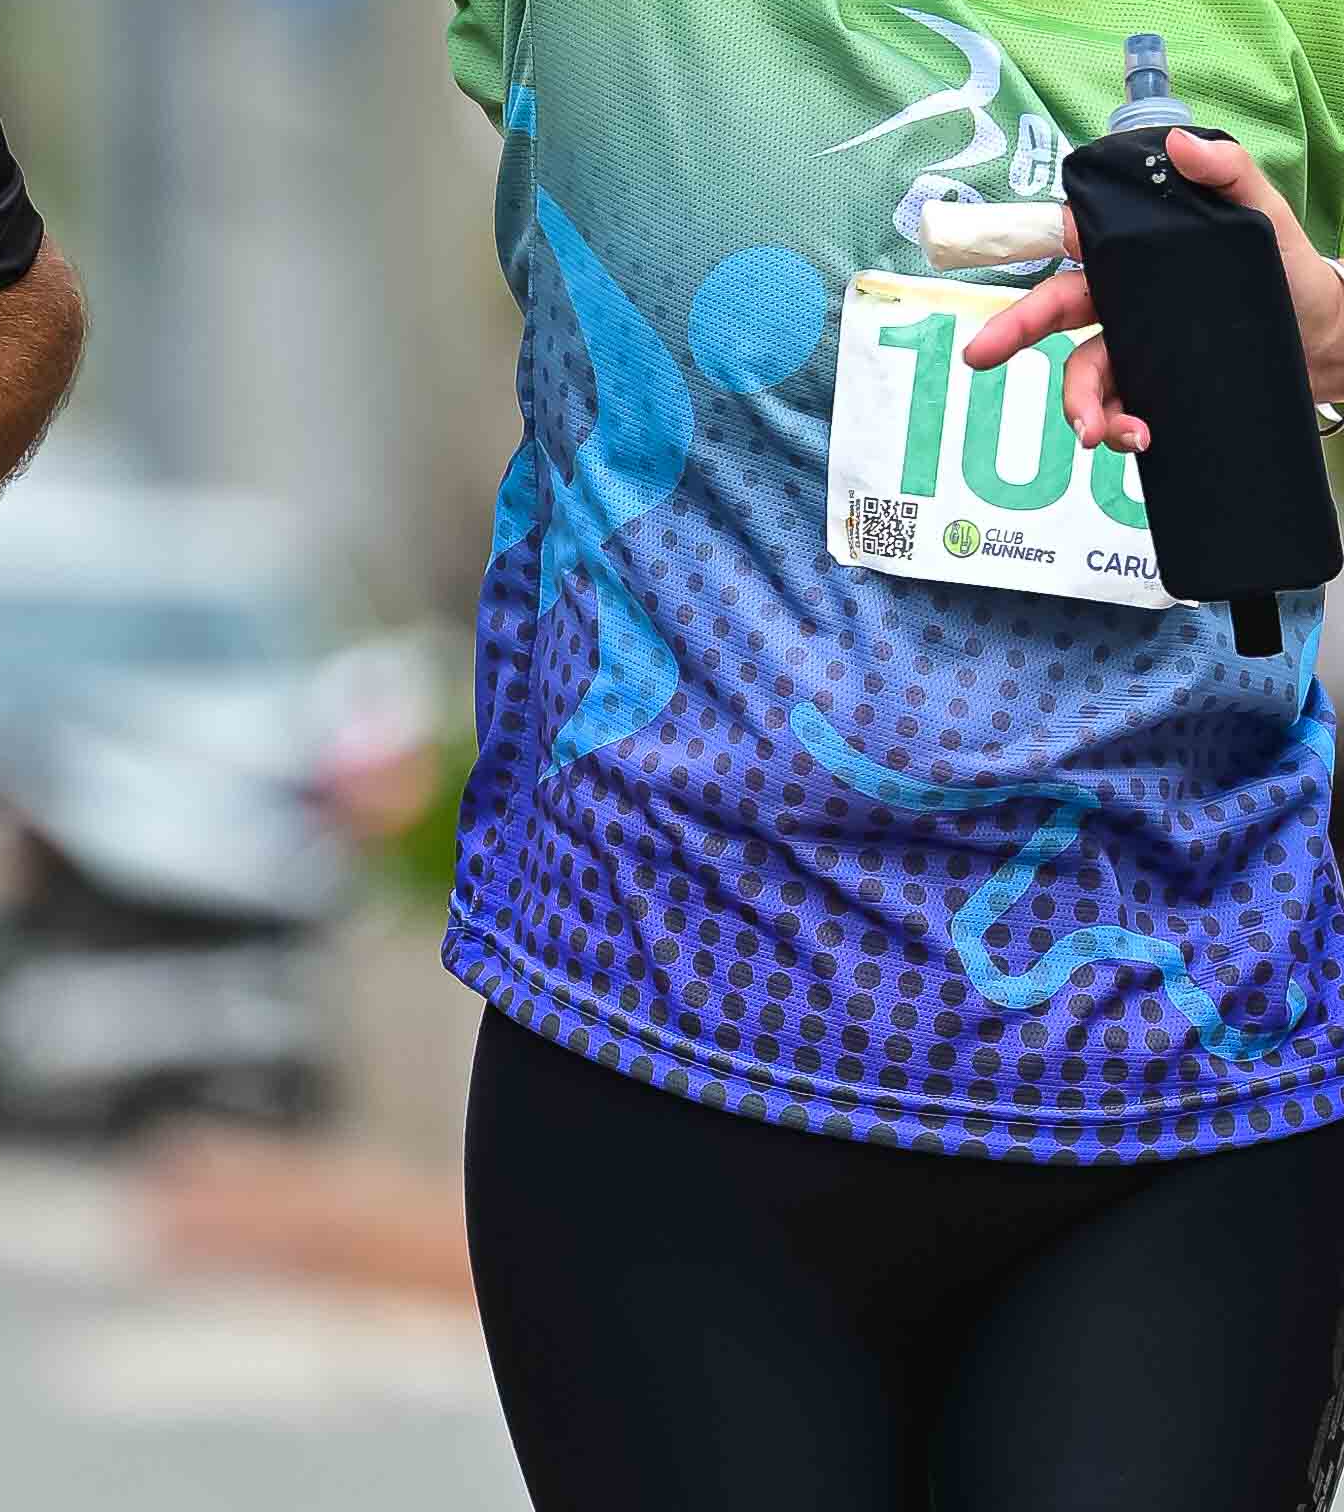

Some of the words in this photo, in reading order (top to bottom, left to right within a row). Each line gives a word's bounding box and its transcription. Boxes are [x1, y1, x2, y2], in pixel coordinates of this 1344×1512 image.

[878, 312, 1150, 530] 10
[985, 528, 1024, 545] CLUB
[981, 542, 1056, 564] RUNNER'S
